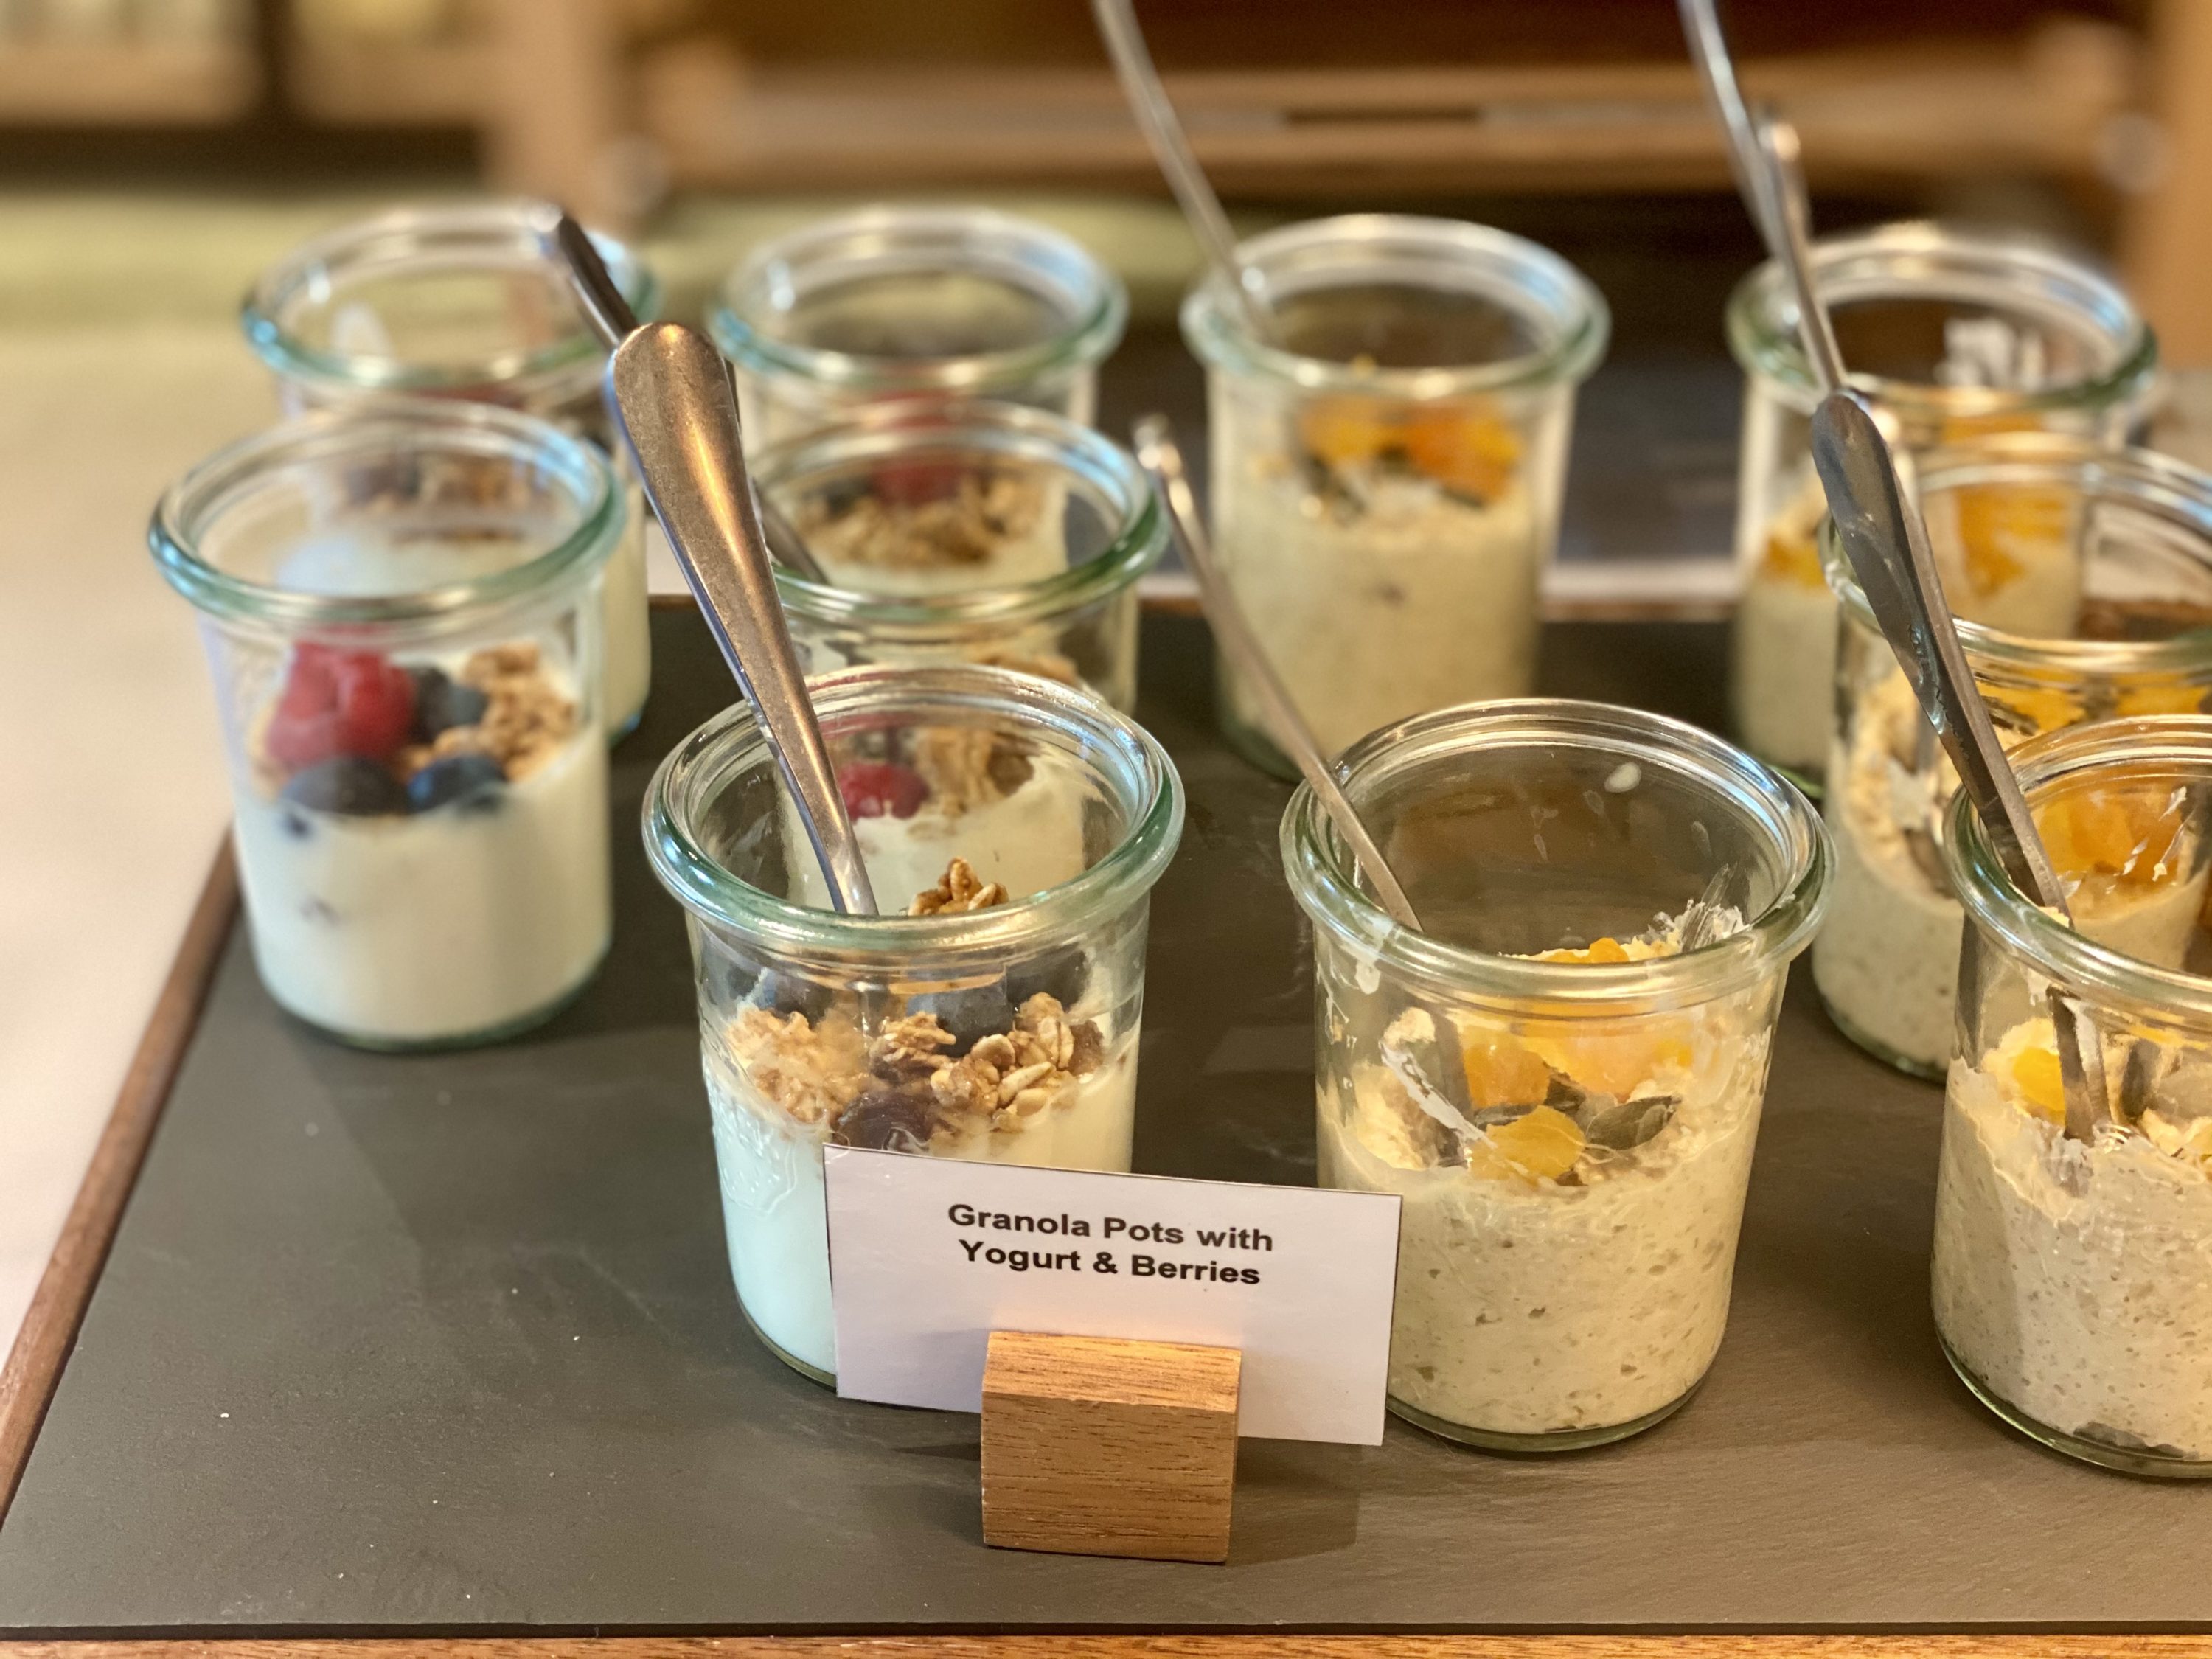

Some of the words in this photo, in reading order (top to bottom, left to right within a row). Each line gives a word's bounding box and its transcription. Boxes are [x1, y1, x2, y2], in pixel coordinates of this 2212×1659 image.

[948, 1204, 1090, 1237] Granola
[1105, 1217, 1184, 1244] Pots
[1197, 1227, 1273, 1251] with
[959, 1239, 1081, 1272] Yogurt
[1093, 1251, 1118, 1274] &
[1131, 1254, 1260, 1285] Berries
